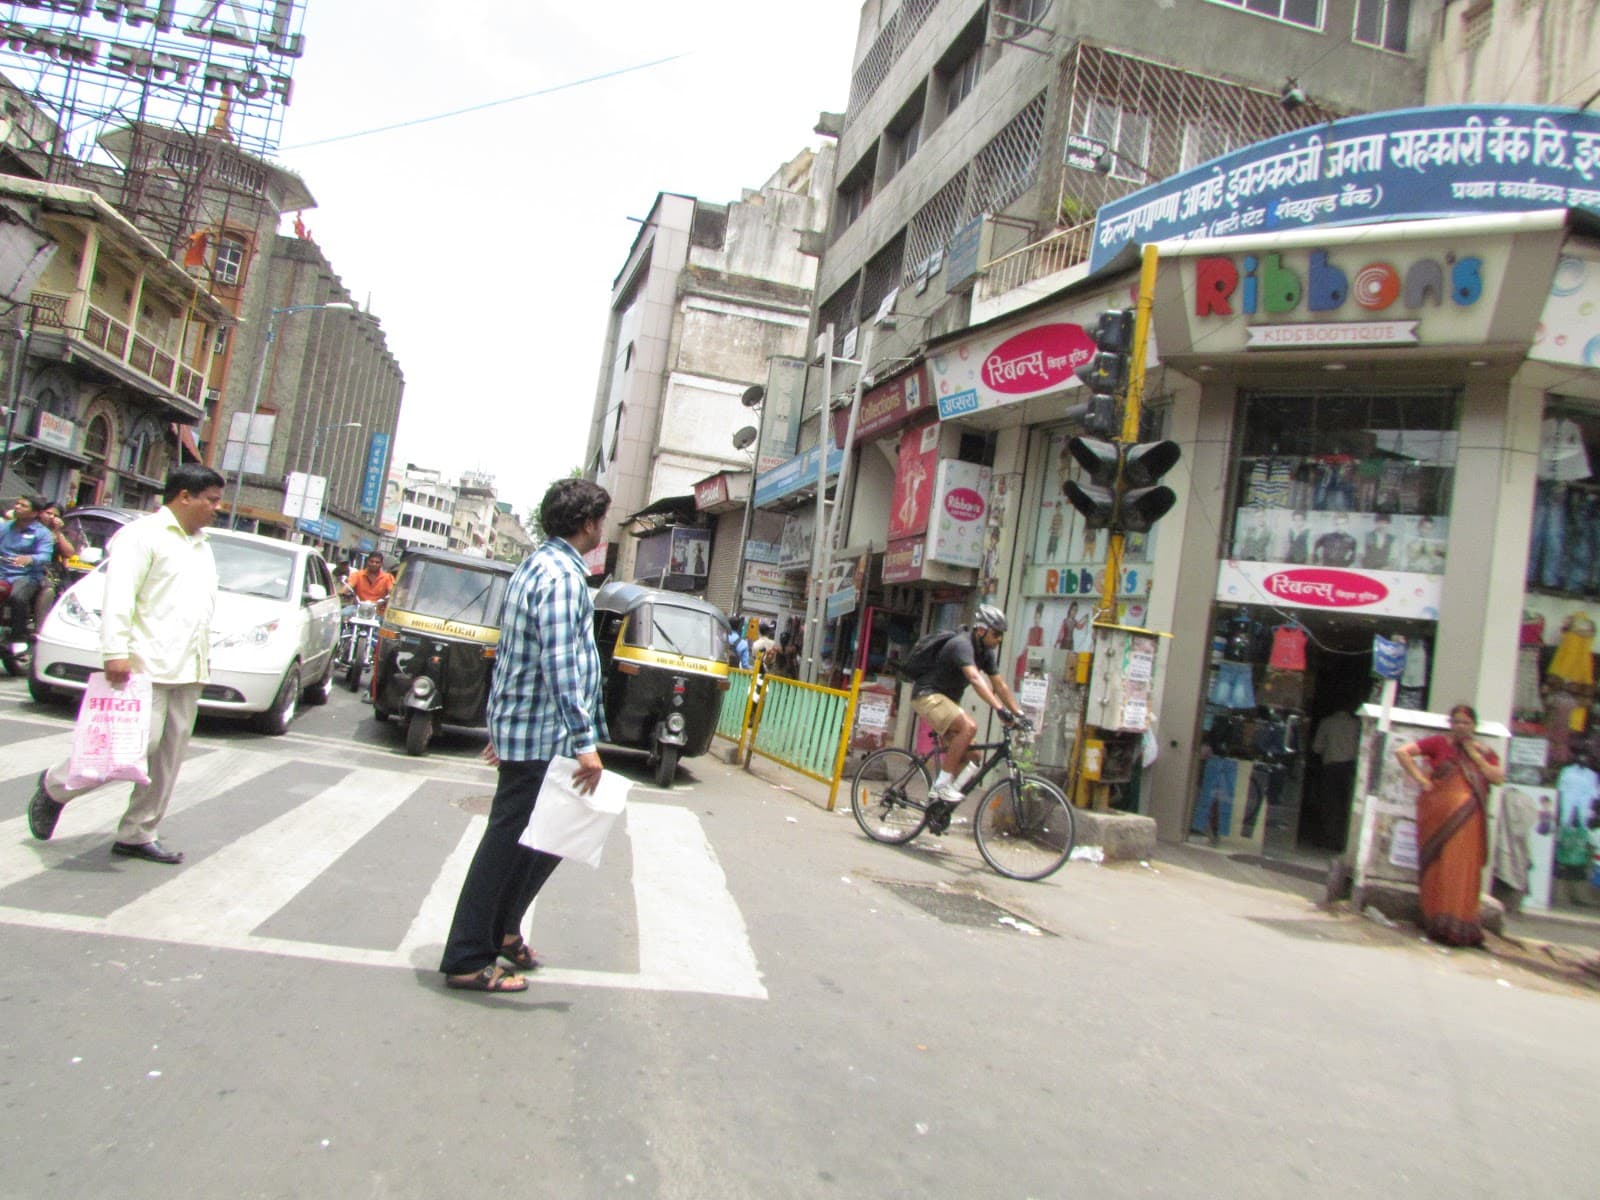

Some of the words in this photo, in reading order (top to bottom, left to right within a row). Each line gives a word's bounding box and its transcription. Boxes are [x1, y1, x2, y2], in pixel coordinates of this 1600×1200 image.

[1225, 134, 1323, 208] इचलकरंजी
[1325, 133, 1387, 178] जनता
[1390, 115, 1486, 174] सहकारी
[1486, 116, 1531, 164] बँक
[1195, 248, 1483, 316] Ribbon's
[90, 697, 141, 712] भारत
